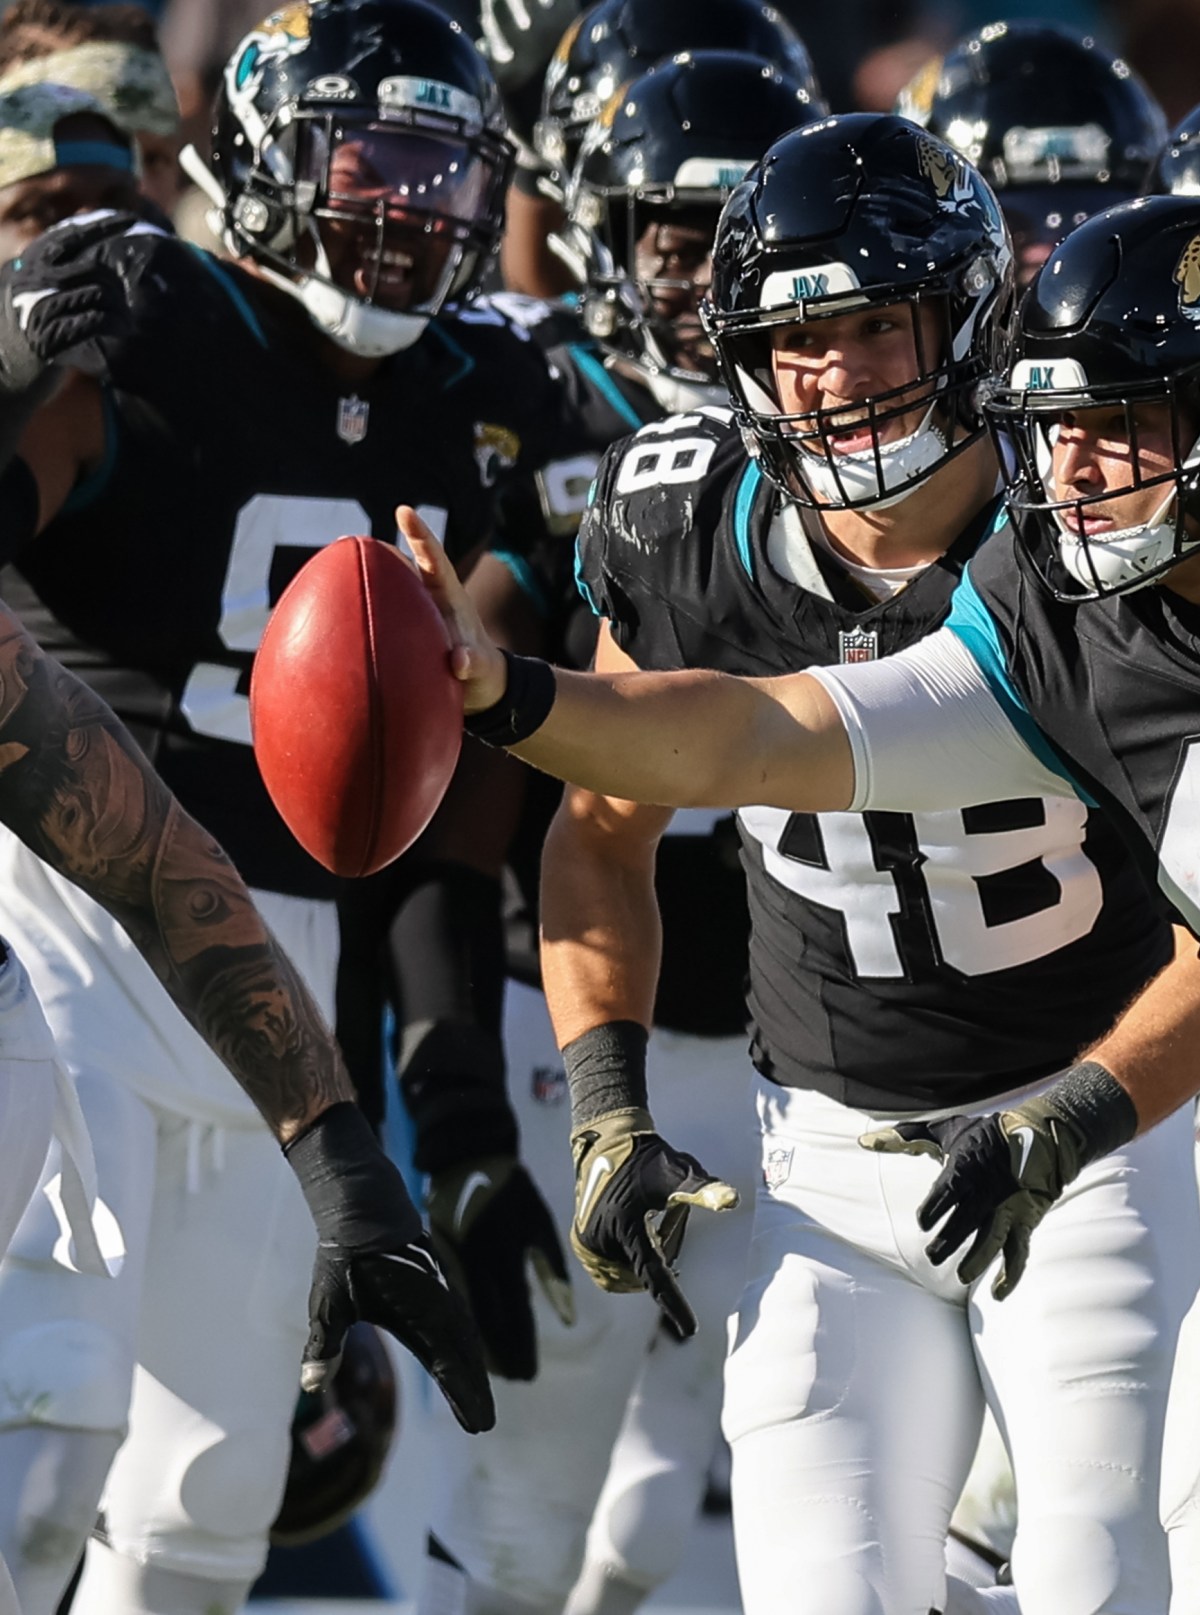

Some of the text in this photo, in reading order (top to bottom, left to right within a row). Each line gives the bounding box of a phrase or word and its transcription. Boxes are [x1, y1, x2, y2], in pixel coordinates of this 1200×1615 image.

[416, 81, 451, 108] JAX
[788, 273, 830, 301] JAX
[1025, 366, 1054, 390] JAX
[738, 796, 1104, 978] 48
